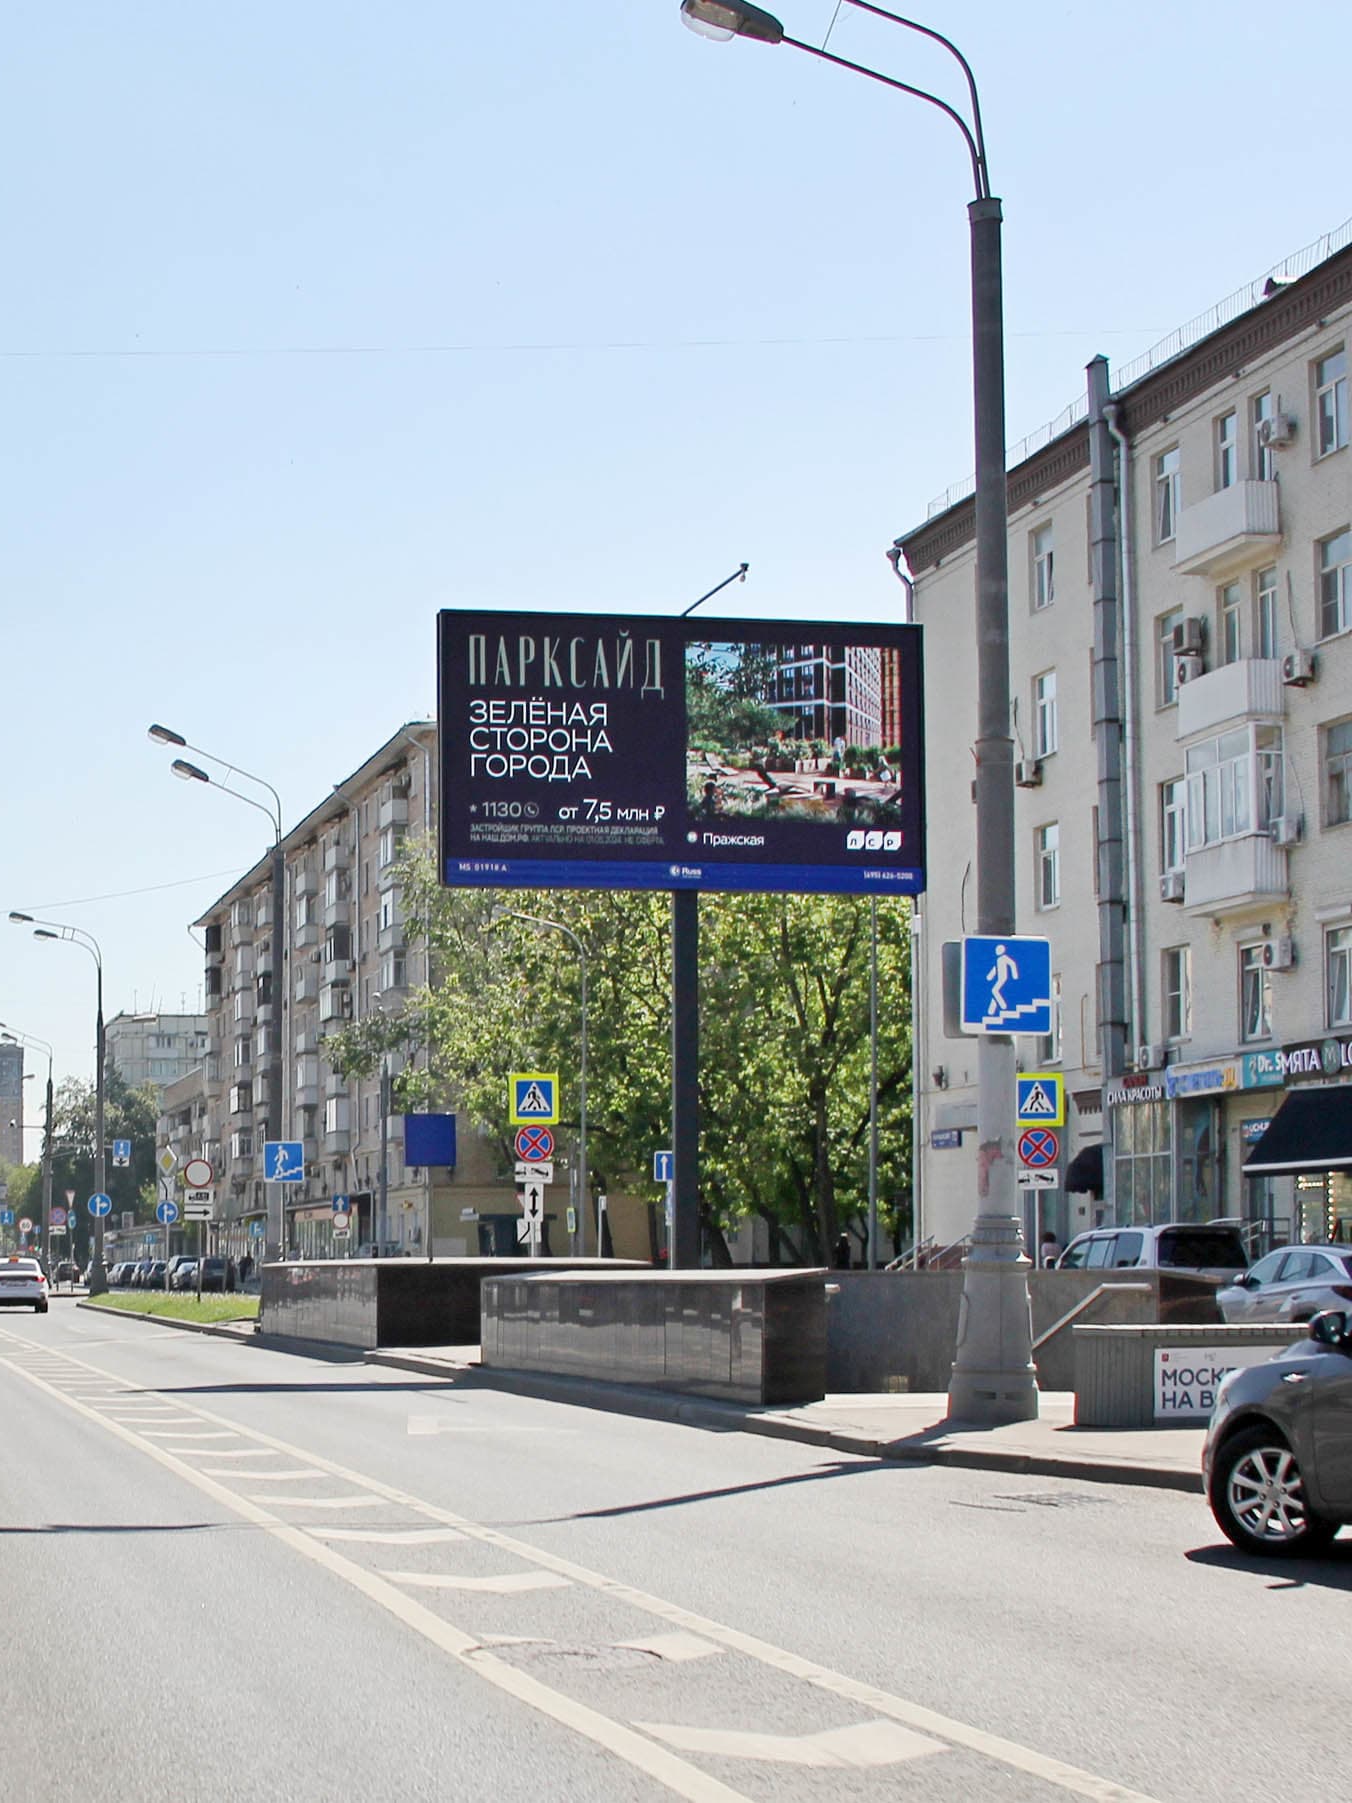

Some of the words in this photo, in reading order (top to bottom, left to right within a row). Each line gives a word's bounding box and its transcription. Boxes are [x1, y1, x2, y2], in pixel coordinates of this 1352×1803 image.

[468, 629, 665, 700] ПАРКСАЙД
[469, 696, 608, 727] ЗЕЛЁНАЯ
[469, 726, 614, 753] СТОРОНА
[470, 754, 593, 783] ГОРОДА
[558, 806, 579, 820] от
[583, 798, 613, 824] 7,5
[617, 808, 649, 821] млн
[703, 832, 765, 847] Пражская
[1280, 1048, 1322, 1076] МЯТА
[1161, 1367, 1237, 1387] МОСК
[1161, 1390, 1193, 1410] НА
